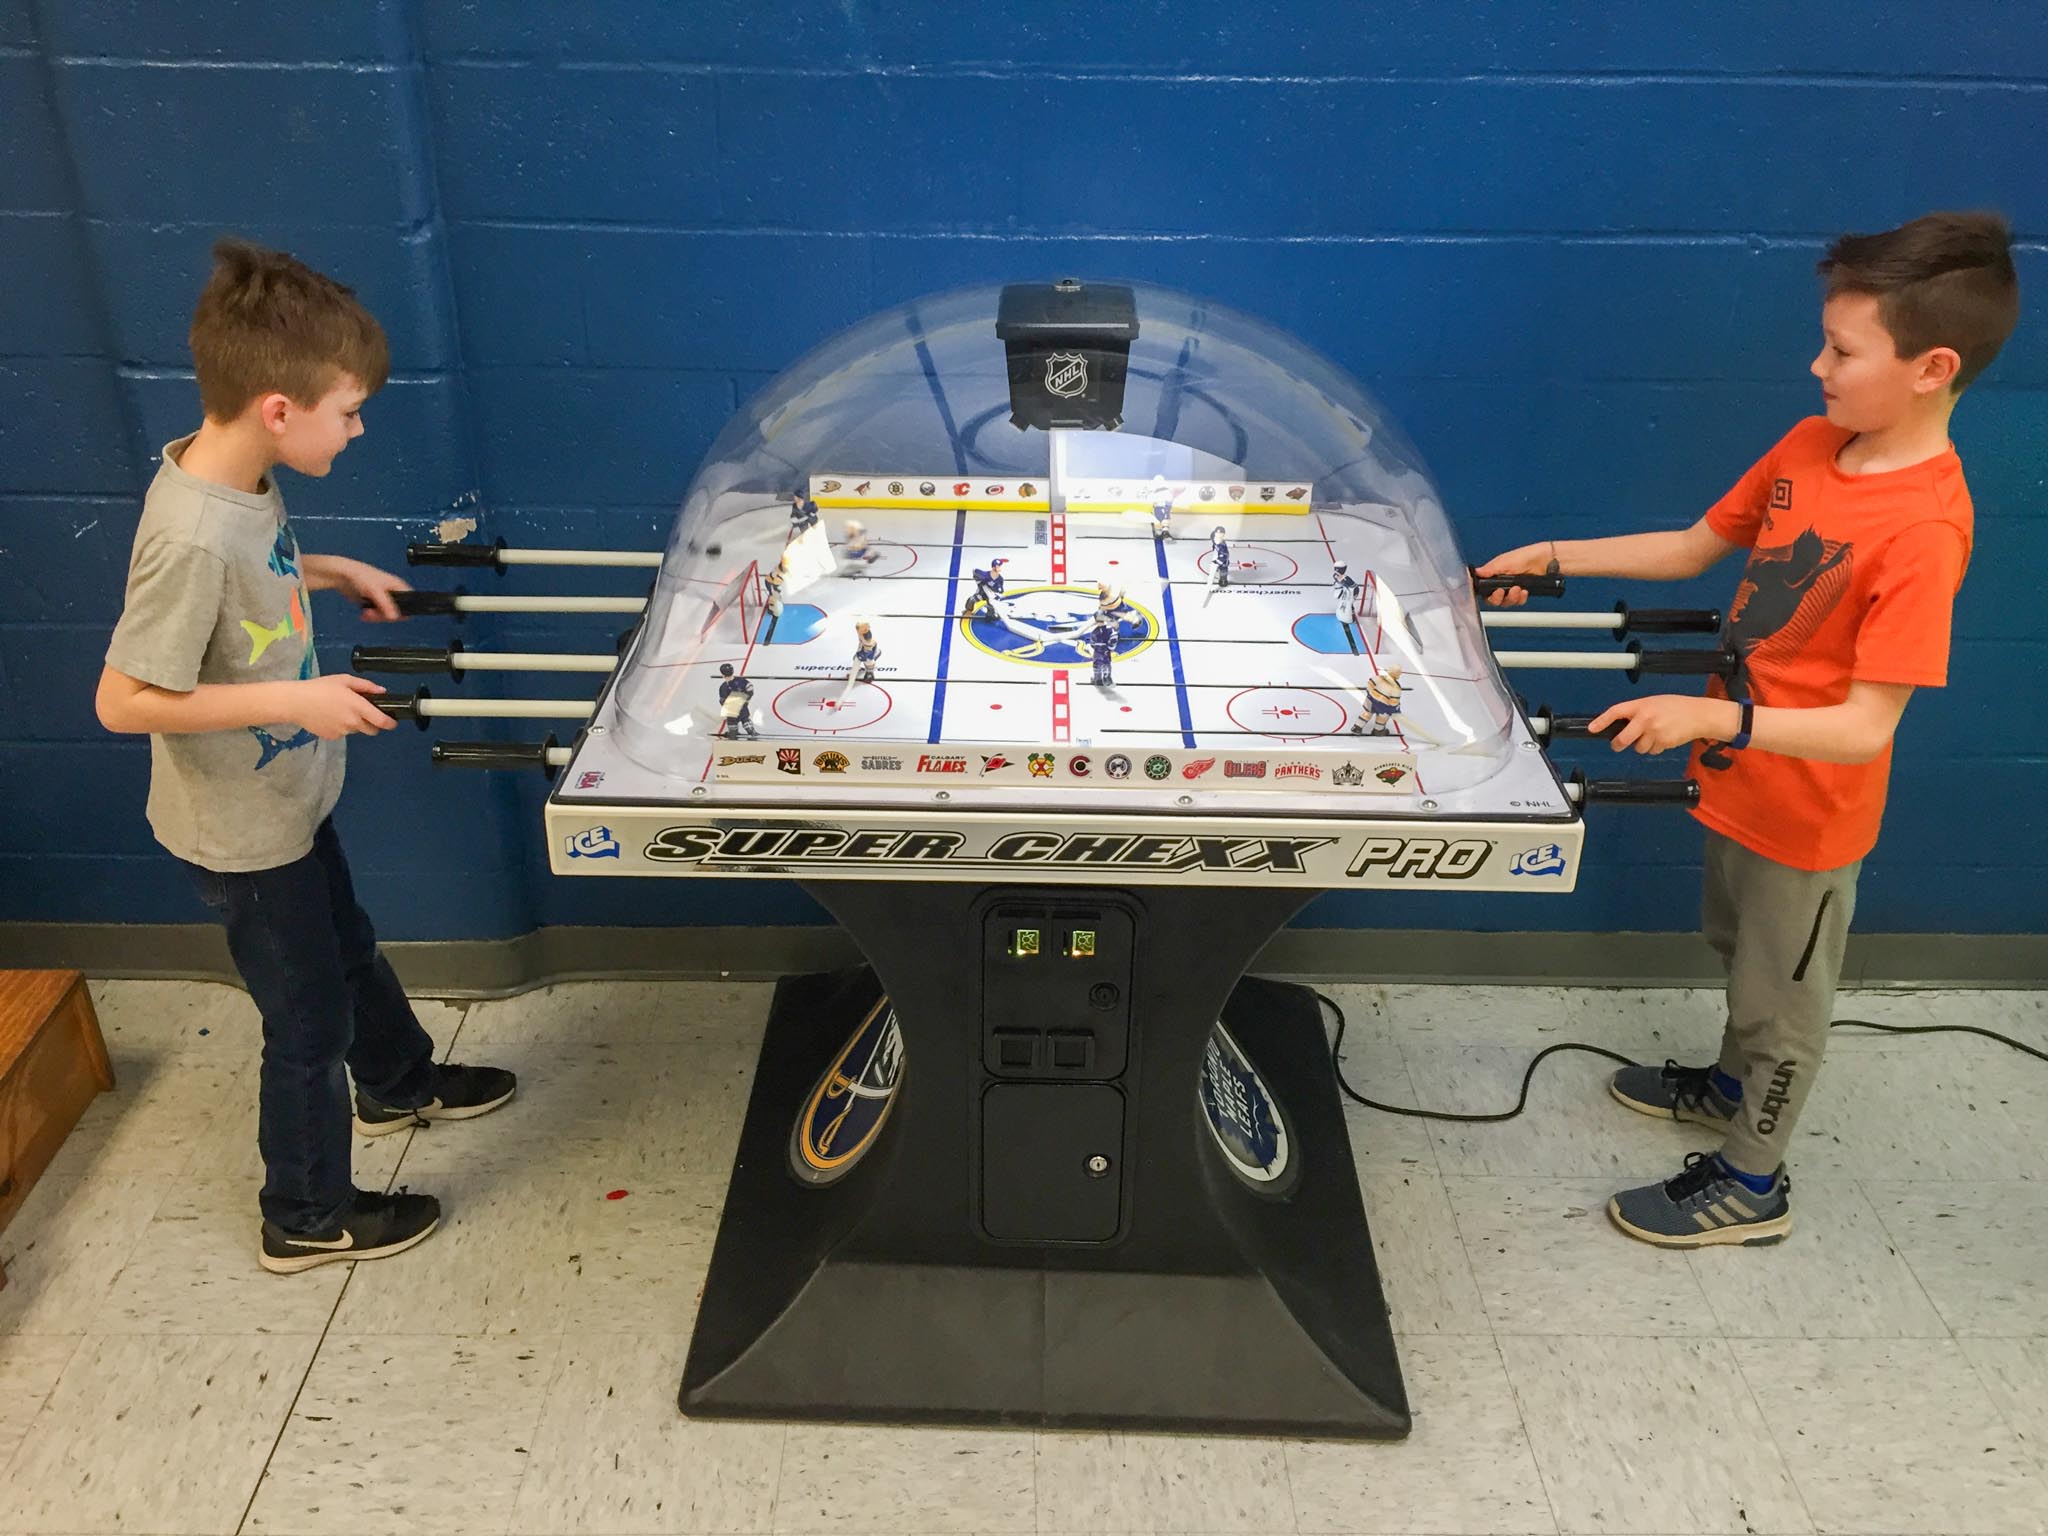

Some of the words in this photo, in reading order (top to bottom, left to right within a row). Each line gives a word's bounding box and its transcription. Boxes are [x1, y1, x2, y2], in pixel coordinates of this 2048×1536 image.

[1055, 364, 1081, 388] NHL
[783, 762, 798, 771] AZ
[861, 759, 902, 771] SABRES
[917, 754, 967, 773] FLAMES
[1275, 765, 1320, 779] PANTHERS
[1526, 800, 1558, 808] NHL
[565, 825, 620, 859] ICE
[644, 826, 967, 864] SUPER
[985, 832, 1341, 873] CHEXX
[1345, 837, 1493, 879] PRO
[1509, 843, 1566, 877] ICE
[1219, 1059, 1239, 1124] MAPLE
[1757, 1060, 1797, 1135] umbro
[1233, 1075, 1254, 1139] LEAFS
